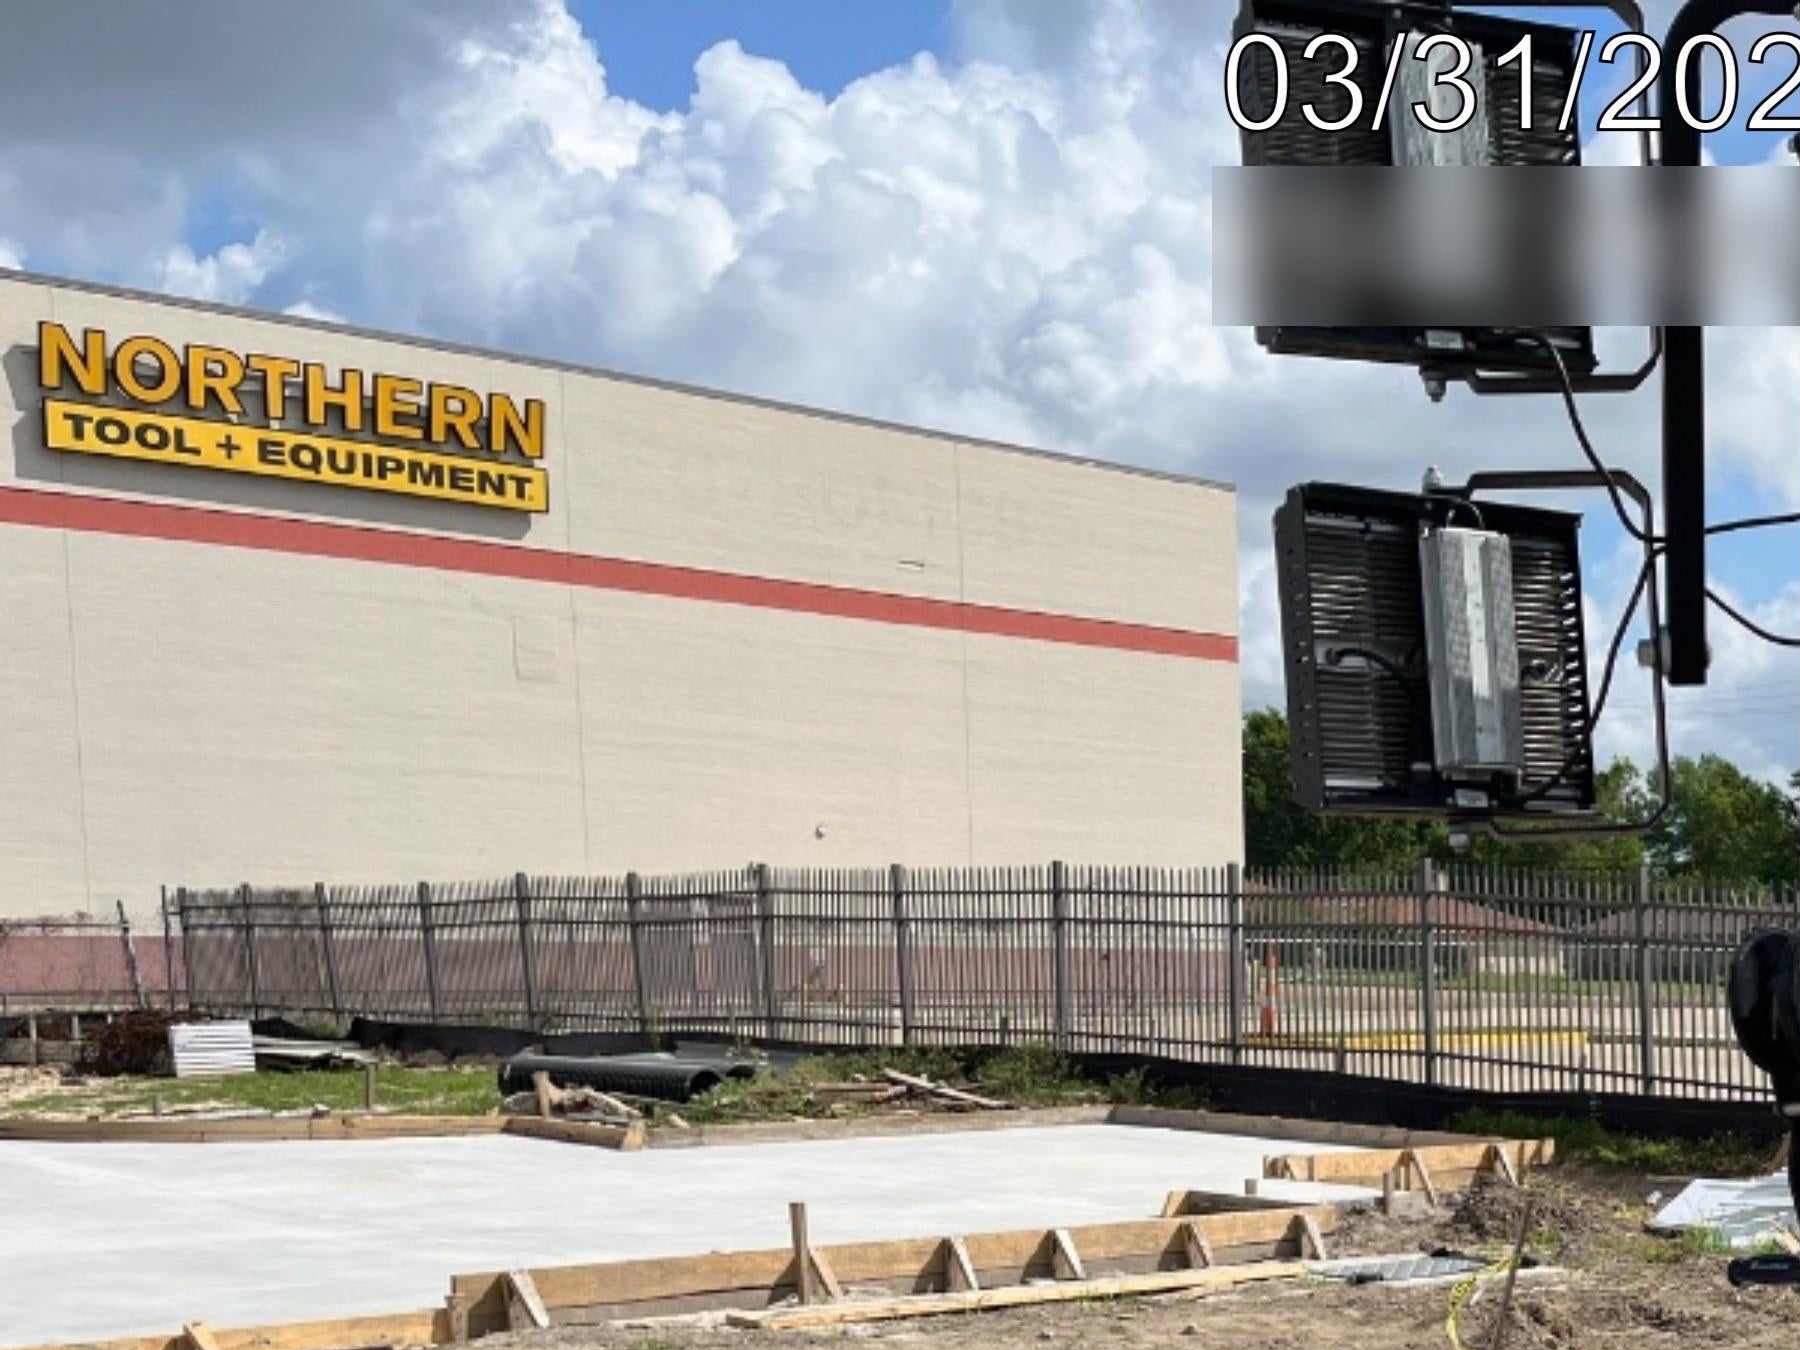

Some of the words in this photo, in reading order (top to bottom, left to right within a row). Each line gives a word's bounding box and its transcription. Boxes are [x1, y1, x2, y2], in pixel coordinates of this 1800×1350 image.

[39, 320, 546, 460] NORTHERN
[63, 412, 202, 457] TOOL
[216, 434, 241, 460] +
[257, 439, 534, 501] EQUIPMENT
